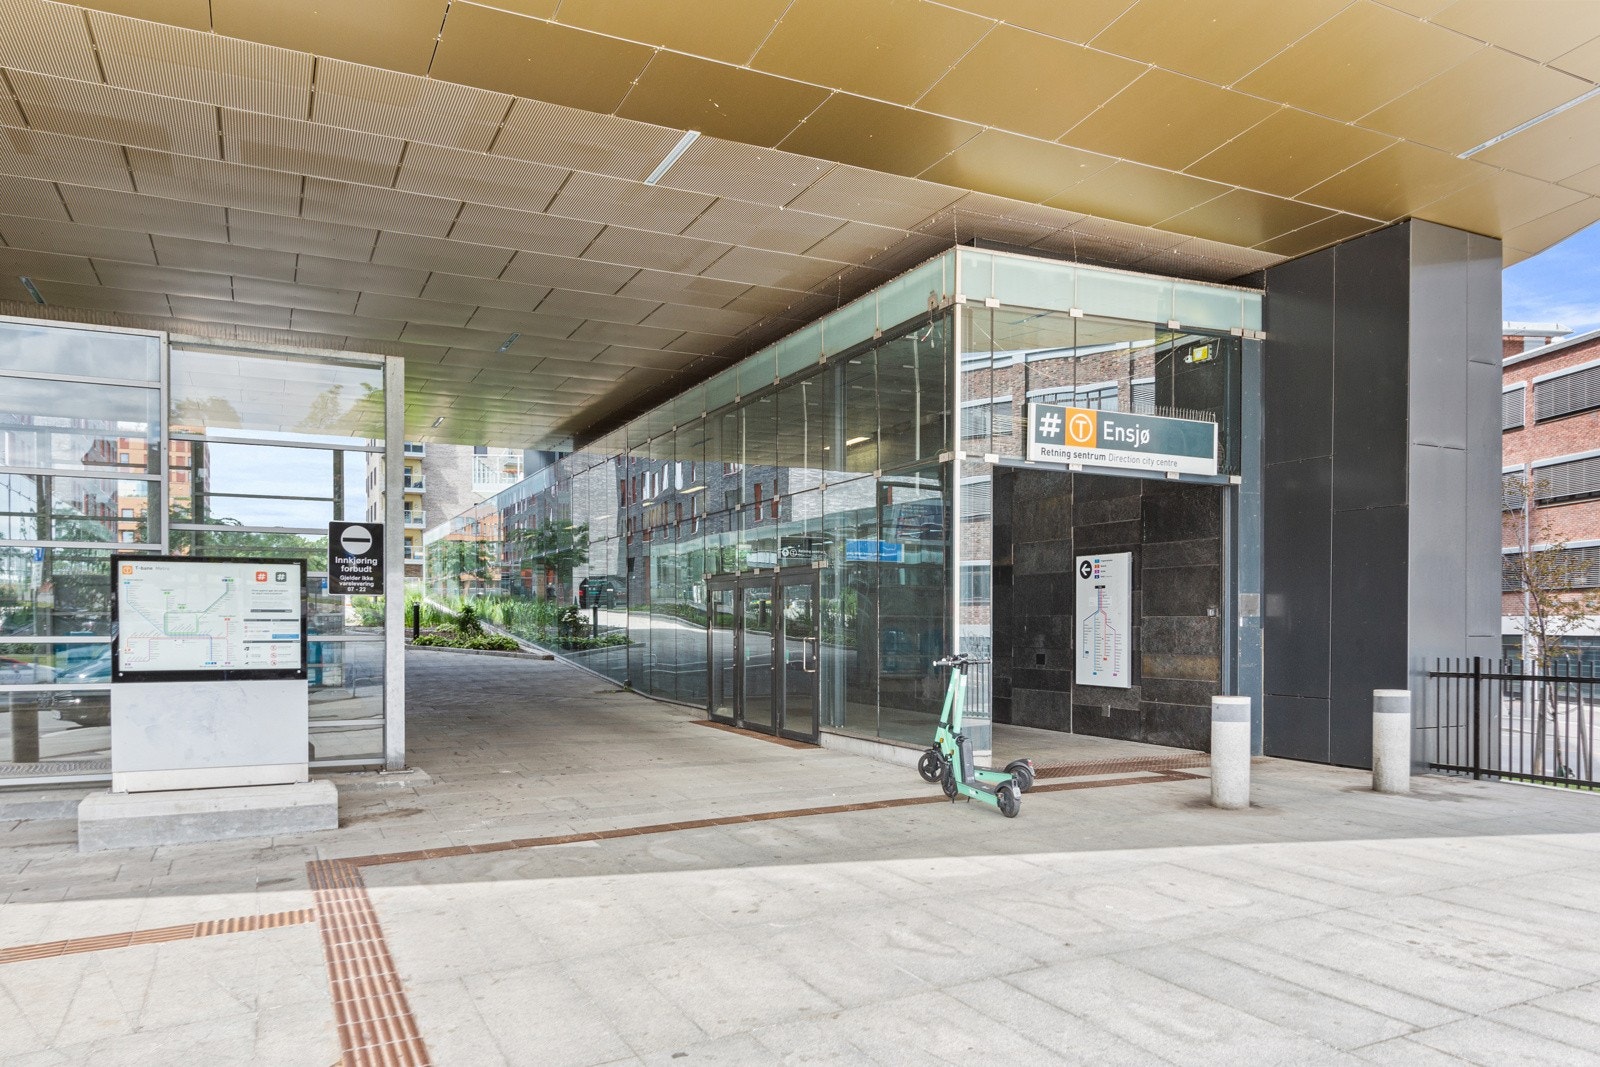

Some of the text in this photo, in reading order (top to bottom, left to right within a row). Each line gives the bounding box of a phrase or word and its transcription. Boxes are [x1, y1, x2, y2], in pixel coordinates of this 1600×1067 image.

[1103, 420, 1151, 448] Ensjø
[1040, 447, 1178, 468] Retning sentrum Direction city centre
[335, 556, 378, 566] Innkjøring
[341, 565, 372, 573] forbudt
